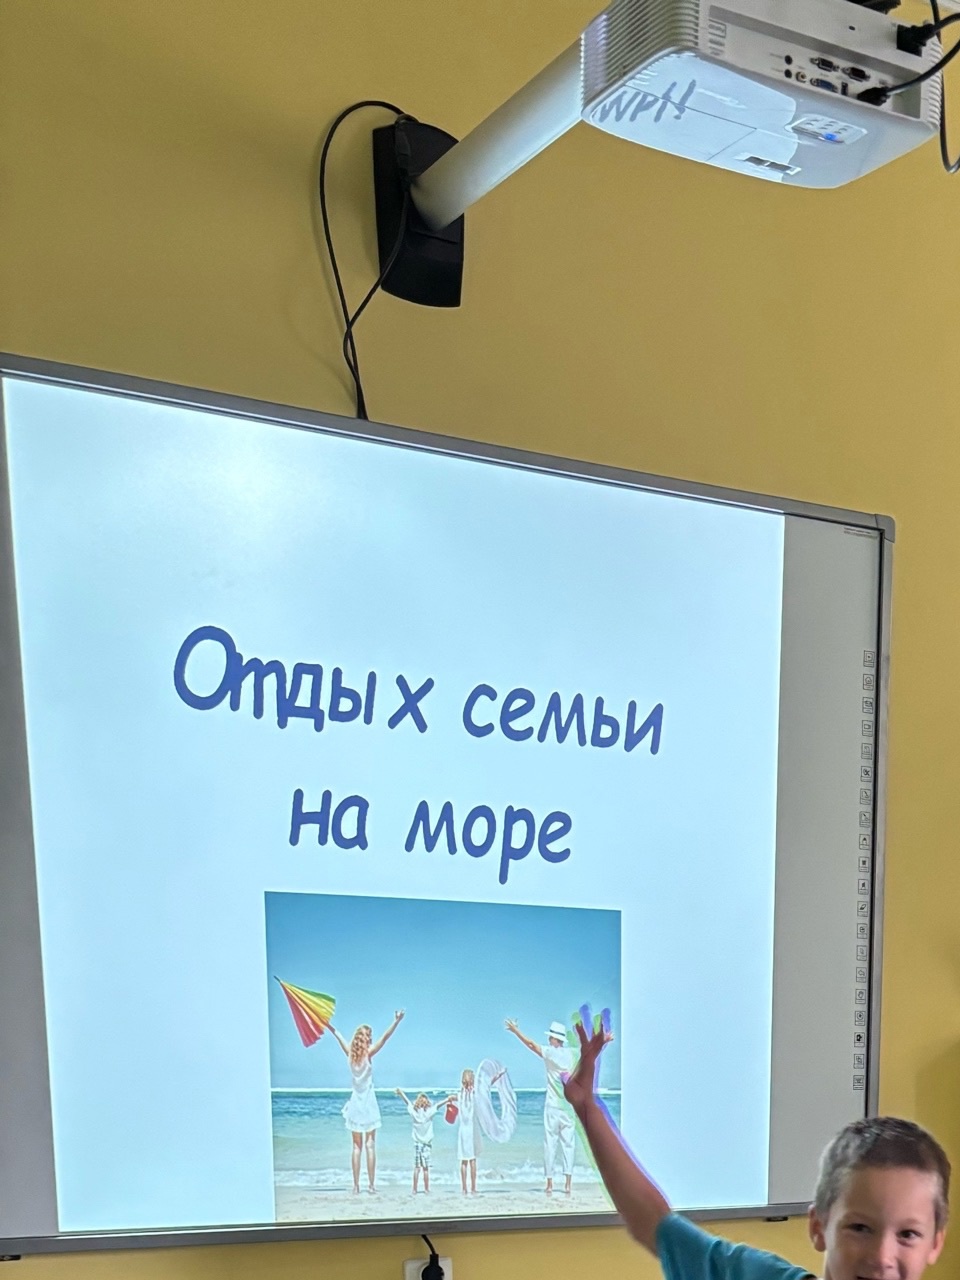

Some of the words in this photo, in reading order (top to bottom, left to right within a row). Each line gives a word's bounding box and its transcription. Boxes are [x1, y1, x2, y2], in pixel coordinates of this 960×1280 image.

[173, 625, 435, 733] Отдых
[462, 683, 664, 756] семьи
[288, 788, 370, 851] на
[404, 799, 573, 885] море
